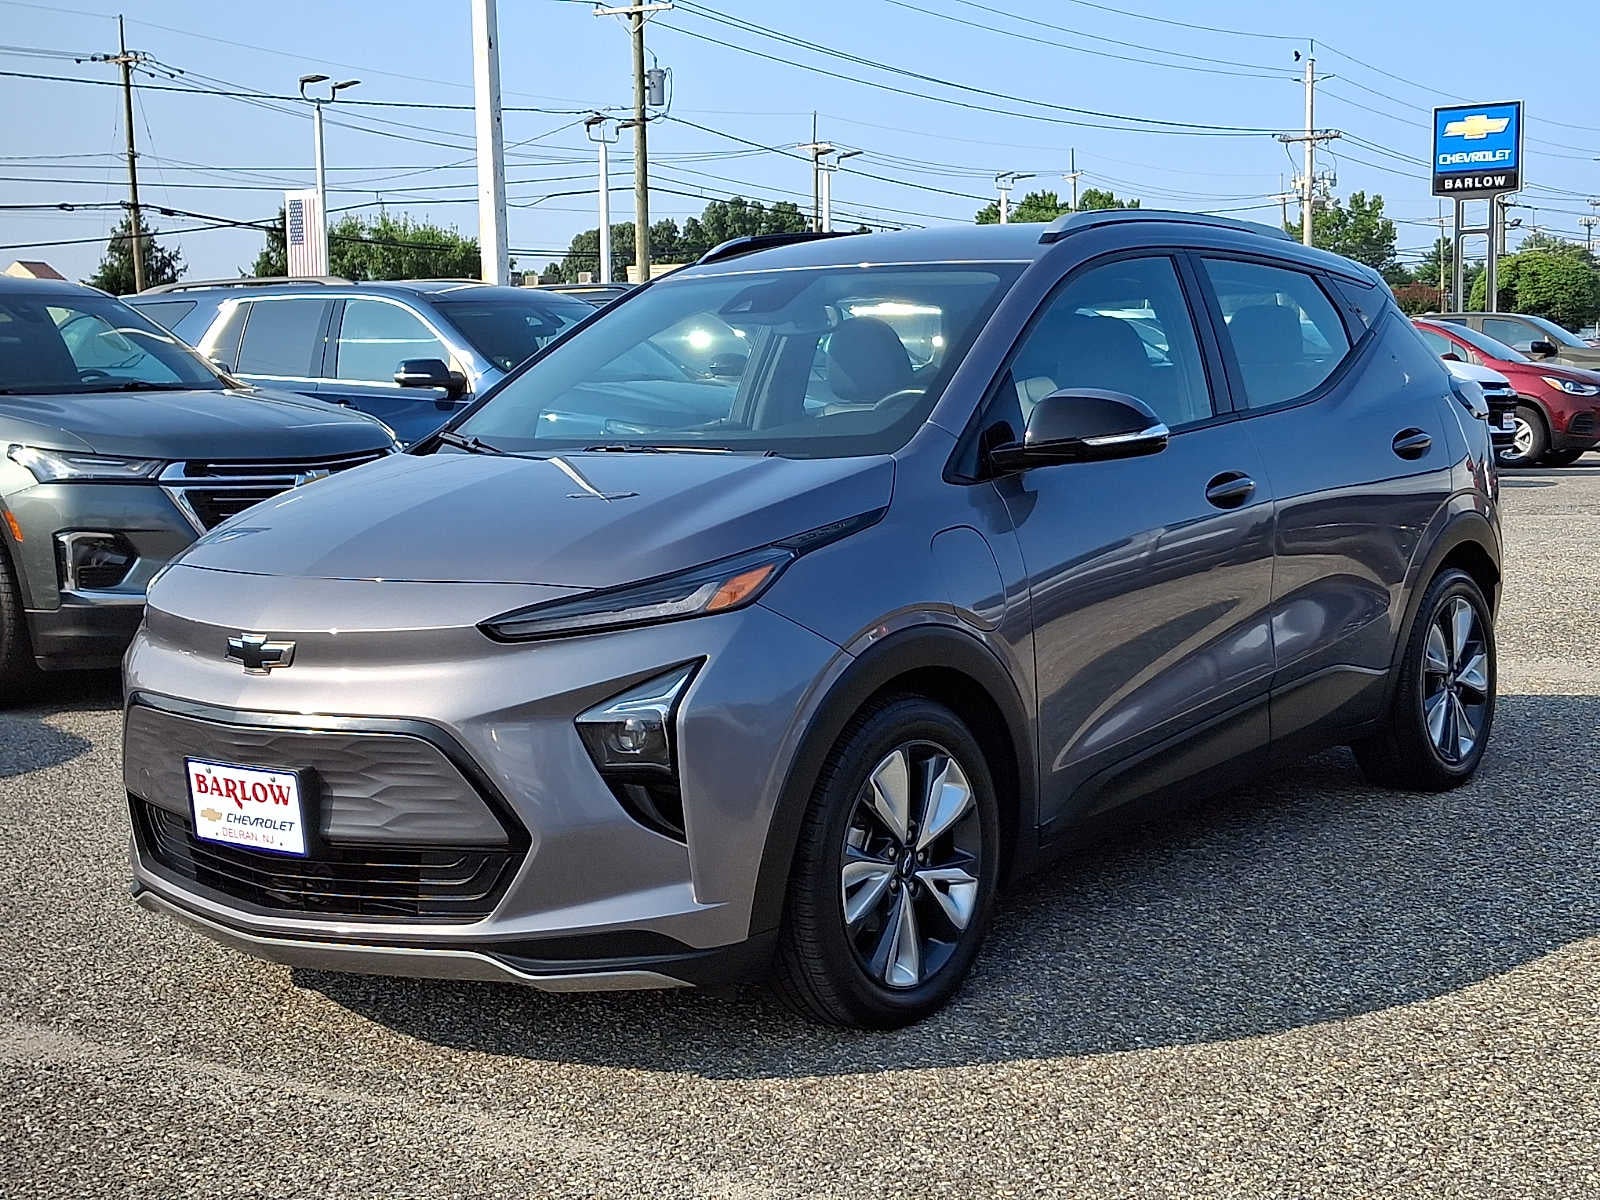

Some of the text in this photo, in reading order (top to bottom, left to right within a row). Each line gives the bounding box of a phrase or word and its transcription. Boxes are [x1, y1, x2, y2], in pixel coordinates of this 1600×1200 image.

[1438, 149, 1511, 165] CHEVROLET
[1444, 176, 1506, 190] BARLOW
[194, 773, 291, 810] BARLOW
[226, 812, 295, 832] CHEVROLET
